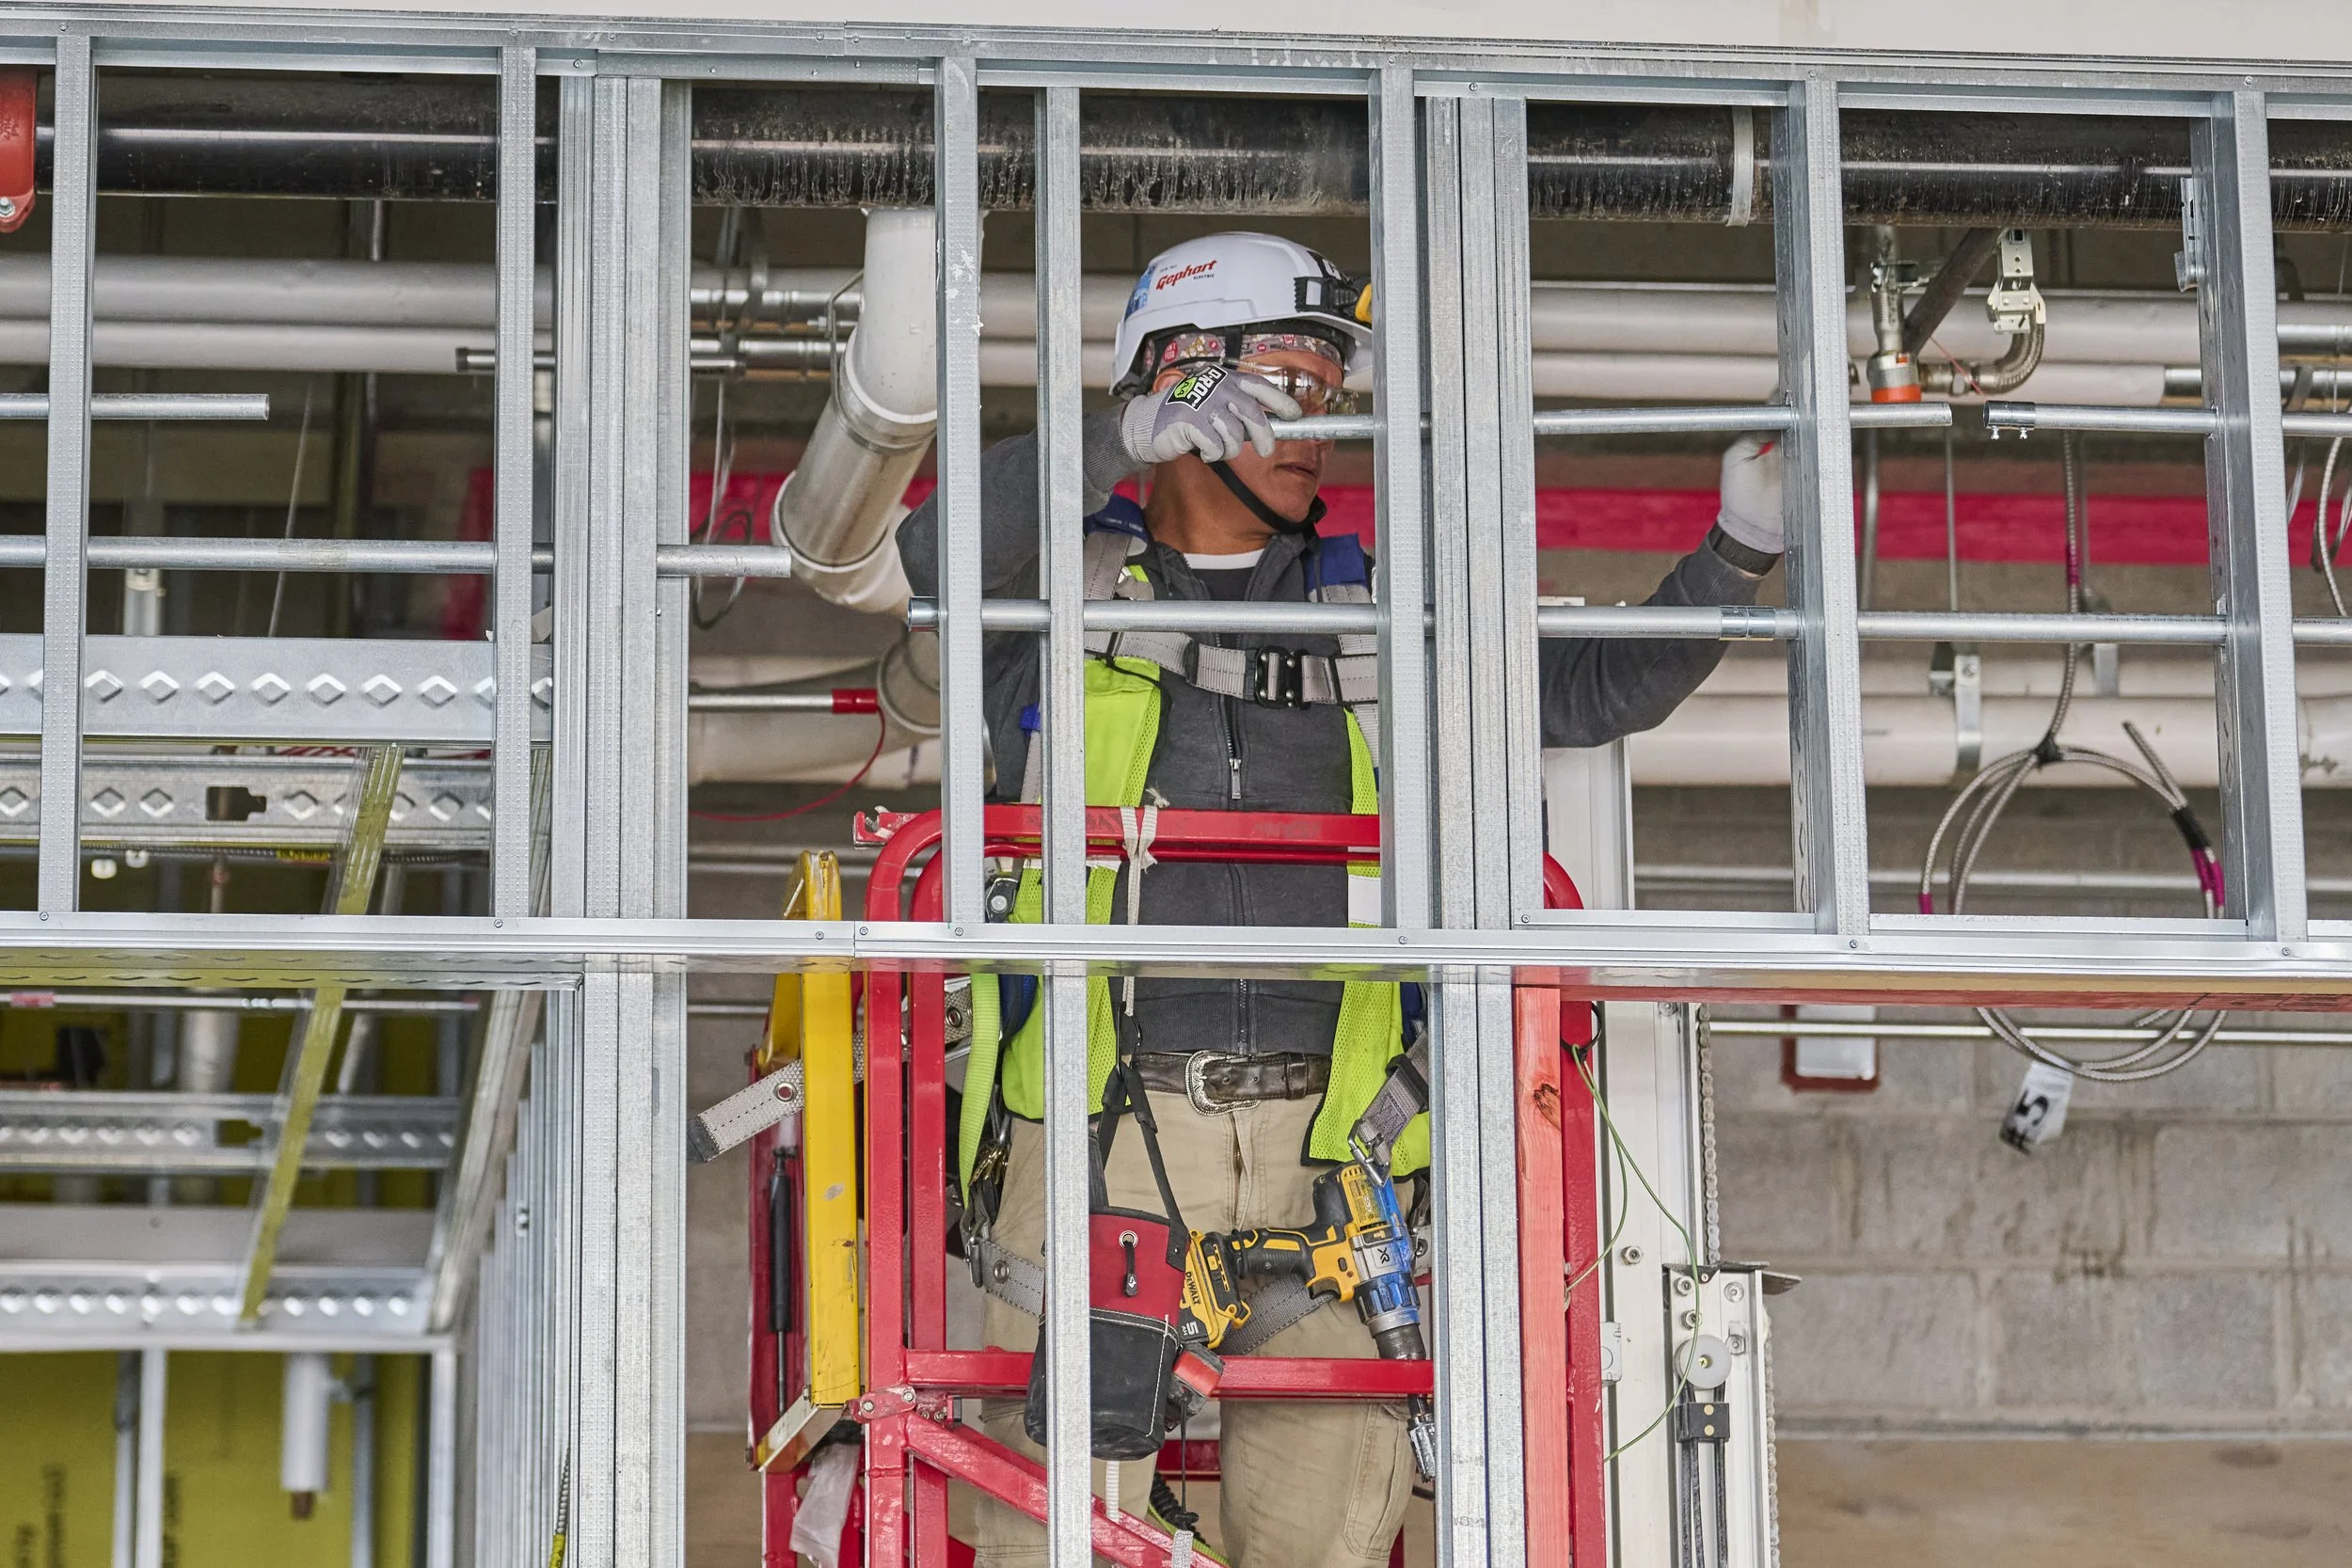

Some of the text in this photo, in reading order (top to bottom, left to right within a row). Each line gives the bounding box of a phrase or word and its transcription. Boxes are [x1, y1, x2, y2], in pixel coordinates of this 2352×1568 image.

[1156, 260, 1217, 291] Gephart
[1377, 1246, 1391, 1264] XR
[1185, 1271, 1200, 1305] DEWALT
[1186, 1322, 1200, 1336] 5
